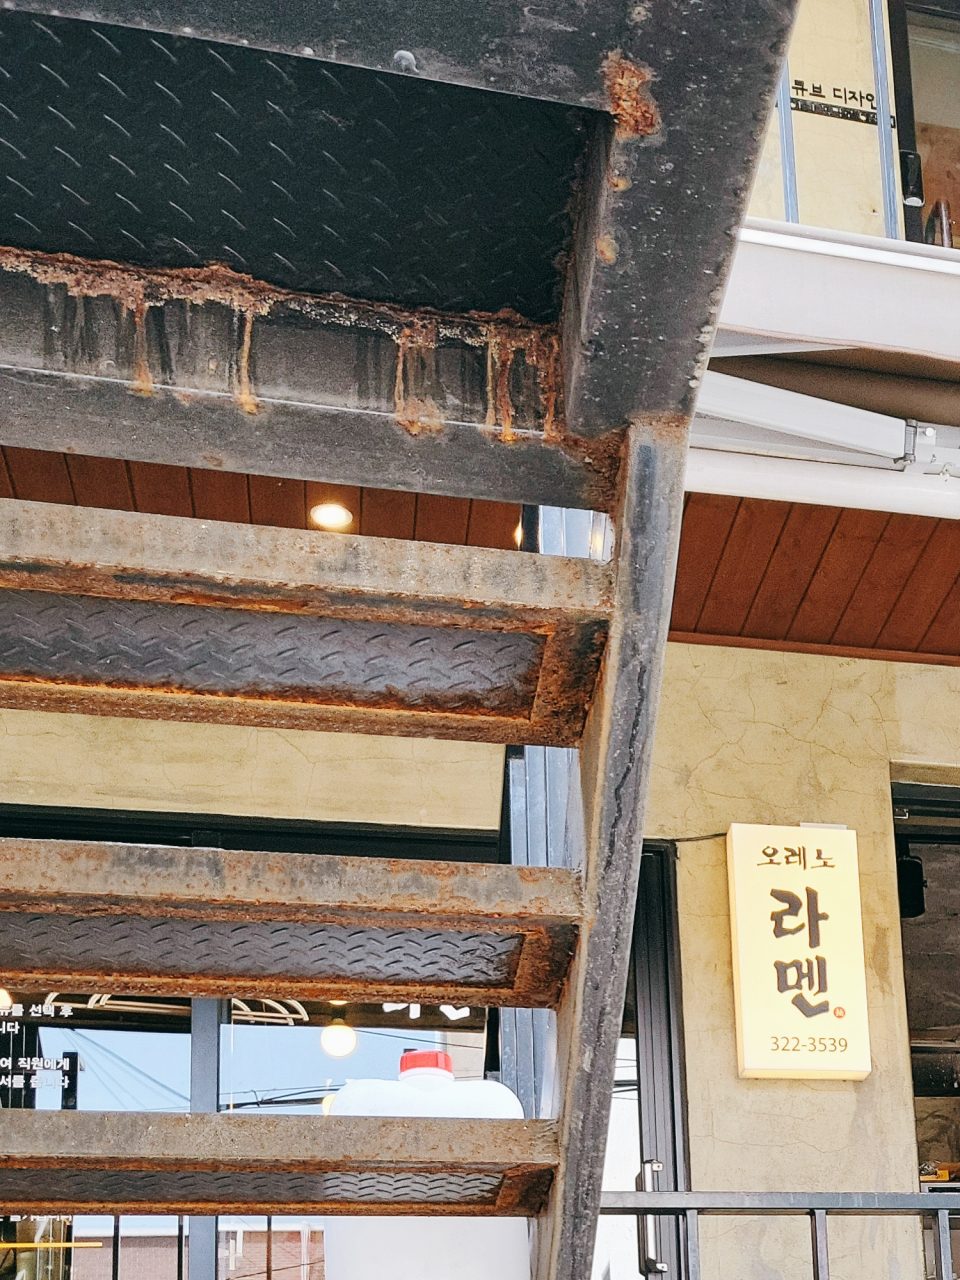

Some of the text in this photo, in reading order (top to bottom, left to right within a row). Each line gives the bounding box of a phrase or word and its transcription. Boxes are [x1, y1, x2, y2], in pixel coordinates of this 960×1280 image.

[792, 80, 826, 98] 큐브
[757, 845, 837, 871] 오레노
[770, 886, 829, 1018] 라멘
[29, 1004, 55, 1017] 선택
[770, 1036, 848, 1053] 322-3539
[18, 1057, 70, 1071] 직원에게
